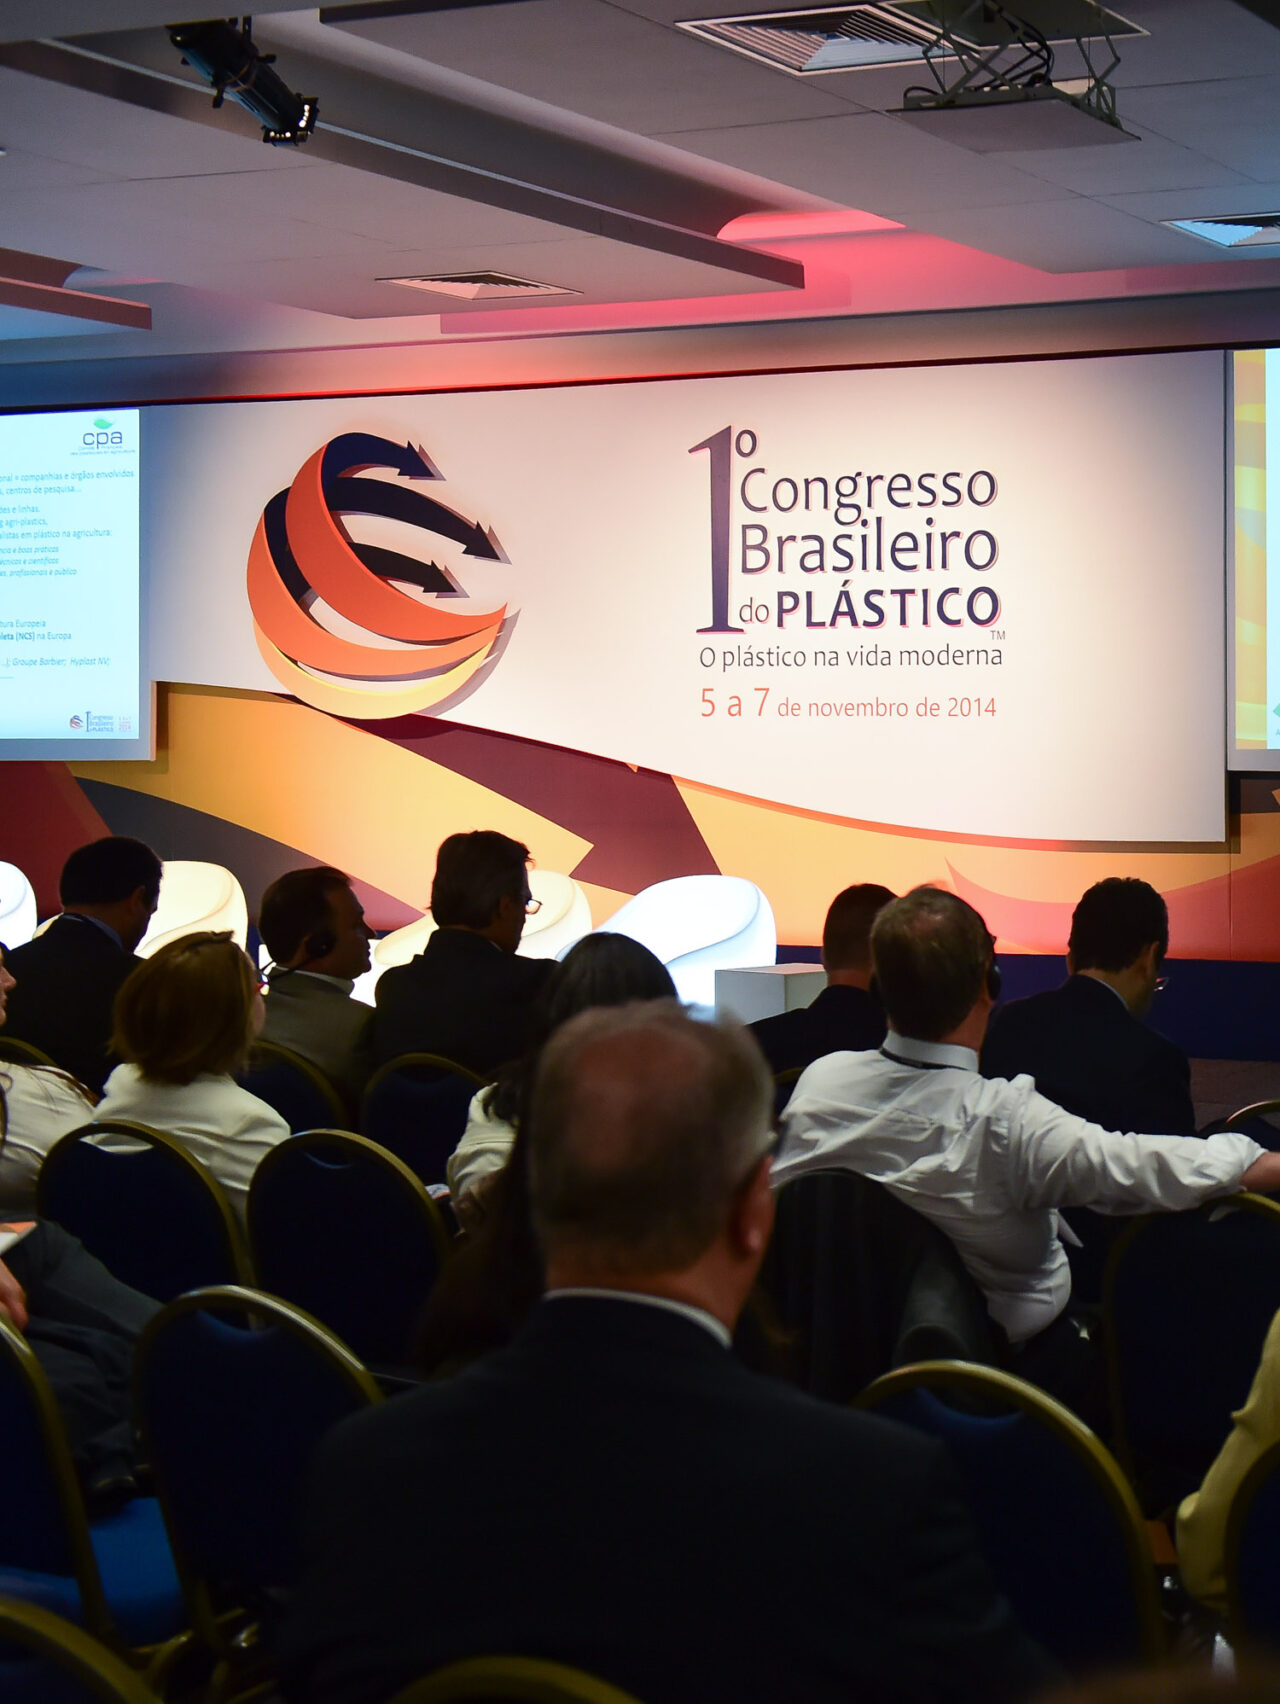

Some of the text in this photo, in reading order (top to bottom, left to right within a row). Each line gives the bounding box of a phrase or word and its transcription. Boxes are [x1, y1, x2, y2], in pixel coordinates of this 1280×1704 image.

[82, 430, 123, 450] cpa
[740, 466, 998, 526] Congresso
[740, 516, 999, 574] Brasileiro
[739, 579, 1002, 629] do PLÁSTICO
[699, 643, 1004, 673] O plástico na vida moderna
[700, 687, 998, 718] 5 a 7 de novembro de 2014
